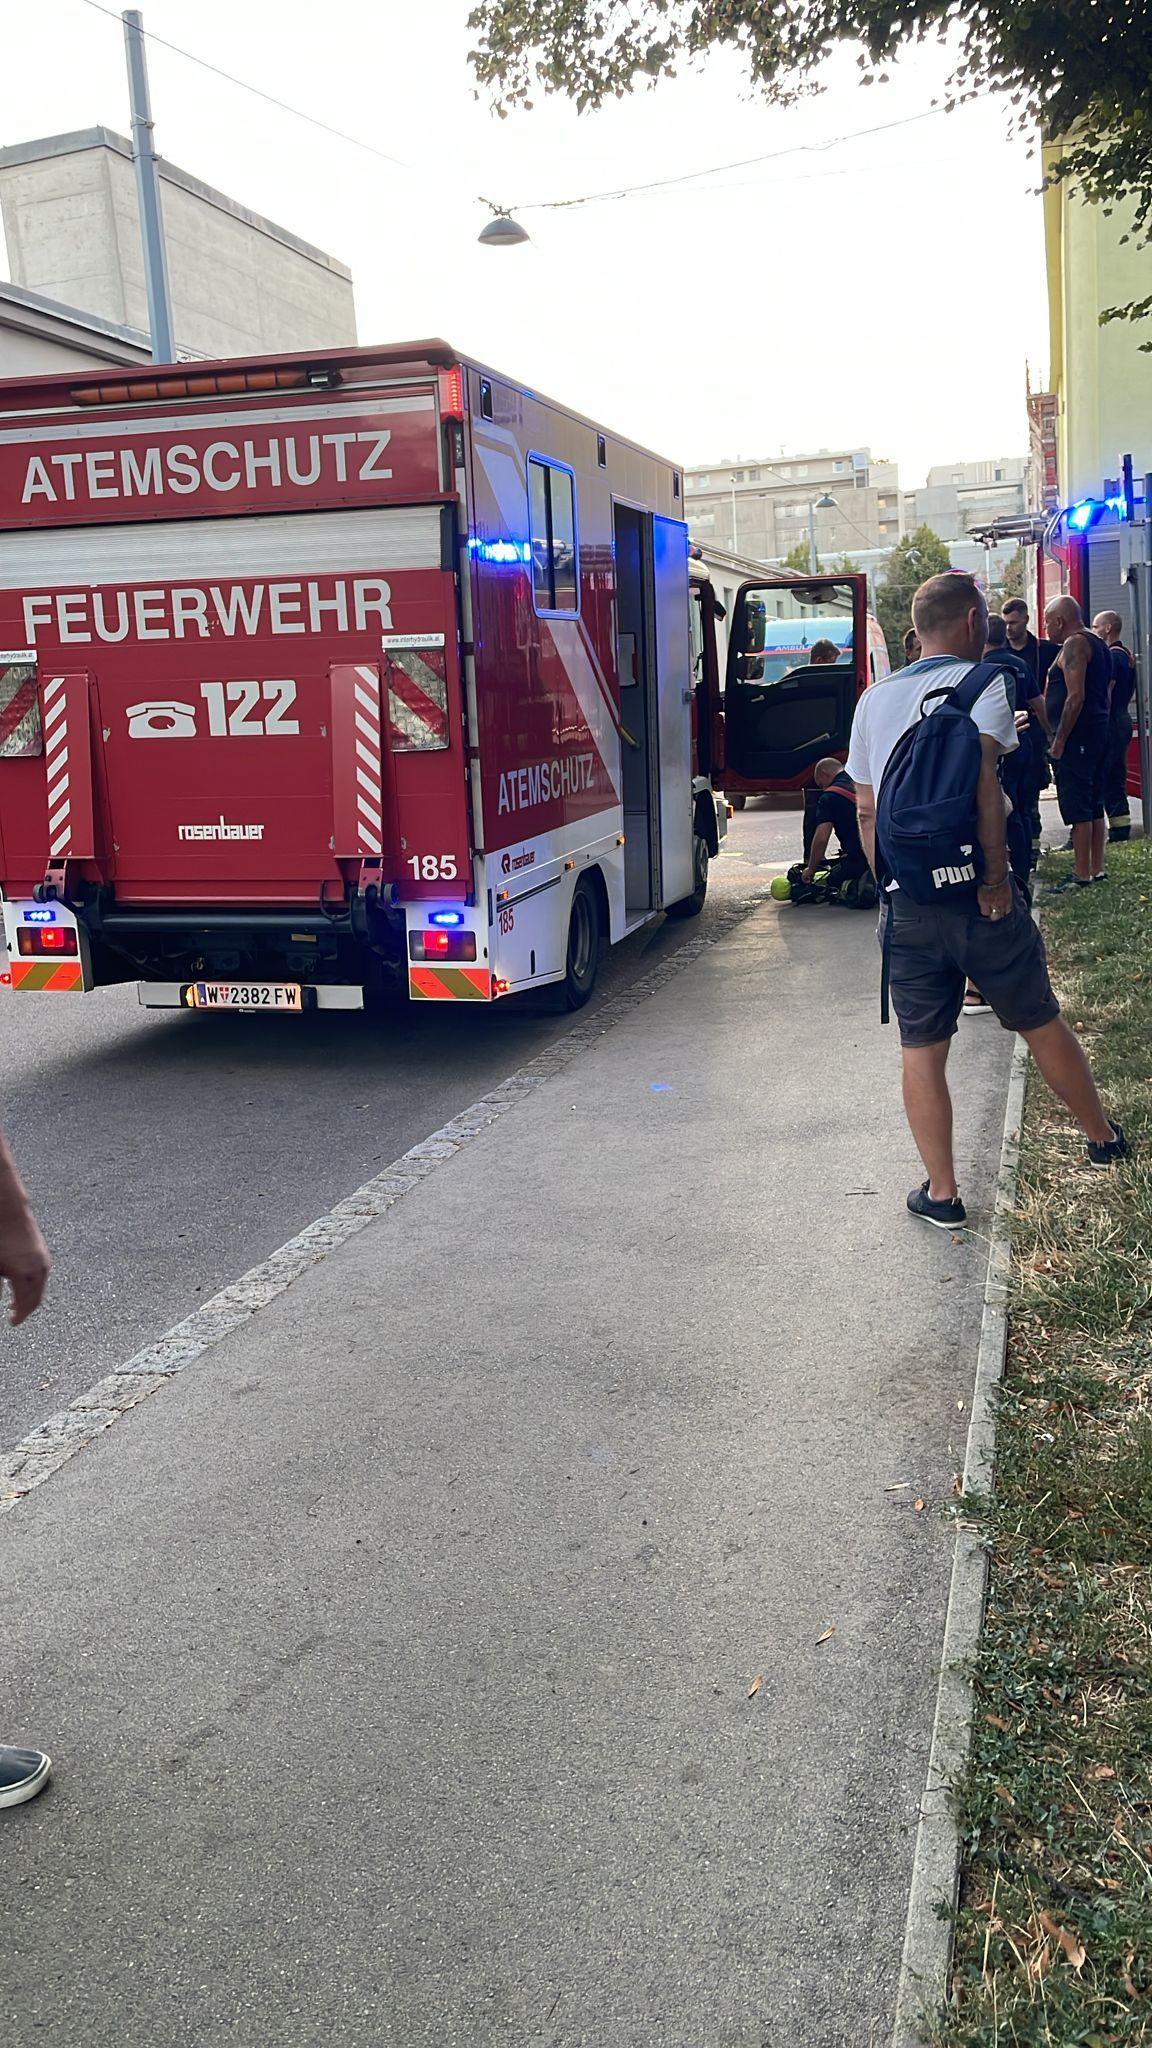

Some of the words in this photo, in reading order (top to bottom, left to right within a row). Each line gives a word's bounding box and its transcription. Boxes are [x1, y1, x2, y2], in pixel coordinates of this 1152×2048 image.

[21, 430, 393, 503] ATEMSCHUTZ
[22, 578, 394, 645] FEUERWEHR
[200, 680, 300, 737] 122
[498, 752, 595, 816] ATEMSCHUTZ
[178, 815, 265, 841] rosenbauer
[407, 855, 458, 881] 185
[498, 907, 514, 936] 185
[207, 987, 219, 1003] W
[230, 987, 270, 1004] 2382
[274, 988, 296, 1005] FW
